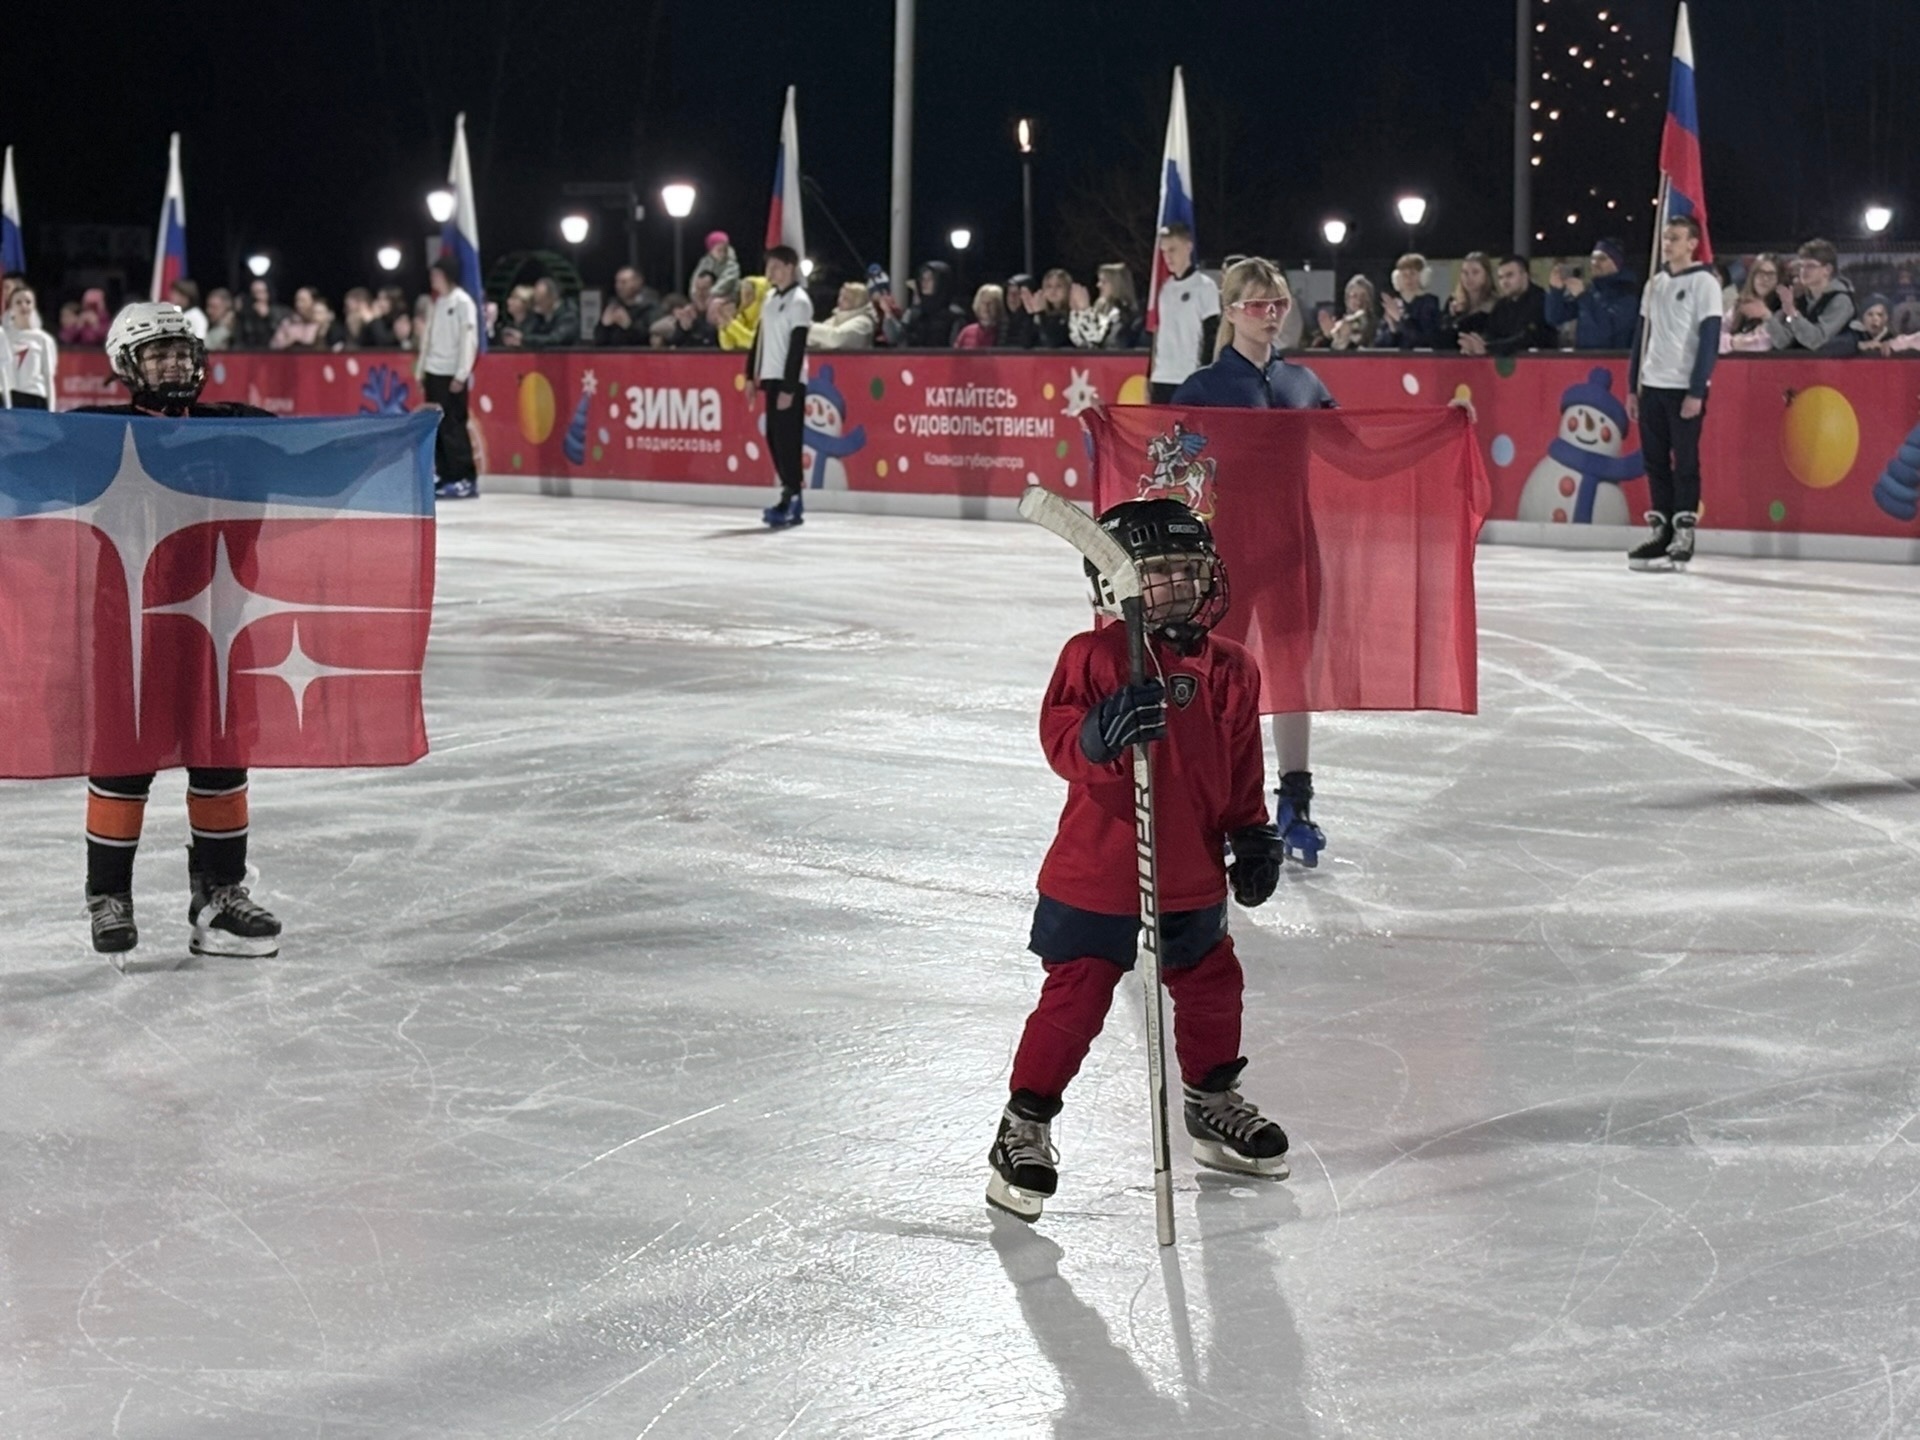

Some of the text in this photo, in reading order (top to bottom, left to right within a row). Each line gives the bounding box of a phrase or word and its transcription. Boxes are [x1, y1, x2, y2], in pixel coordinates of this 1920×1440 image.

[925, 383, 1018, 408] КАТАЙТЕСЬ
[893, 414, 1054, 437] С УДОВОЛЬСТВИЕМ!
